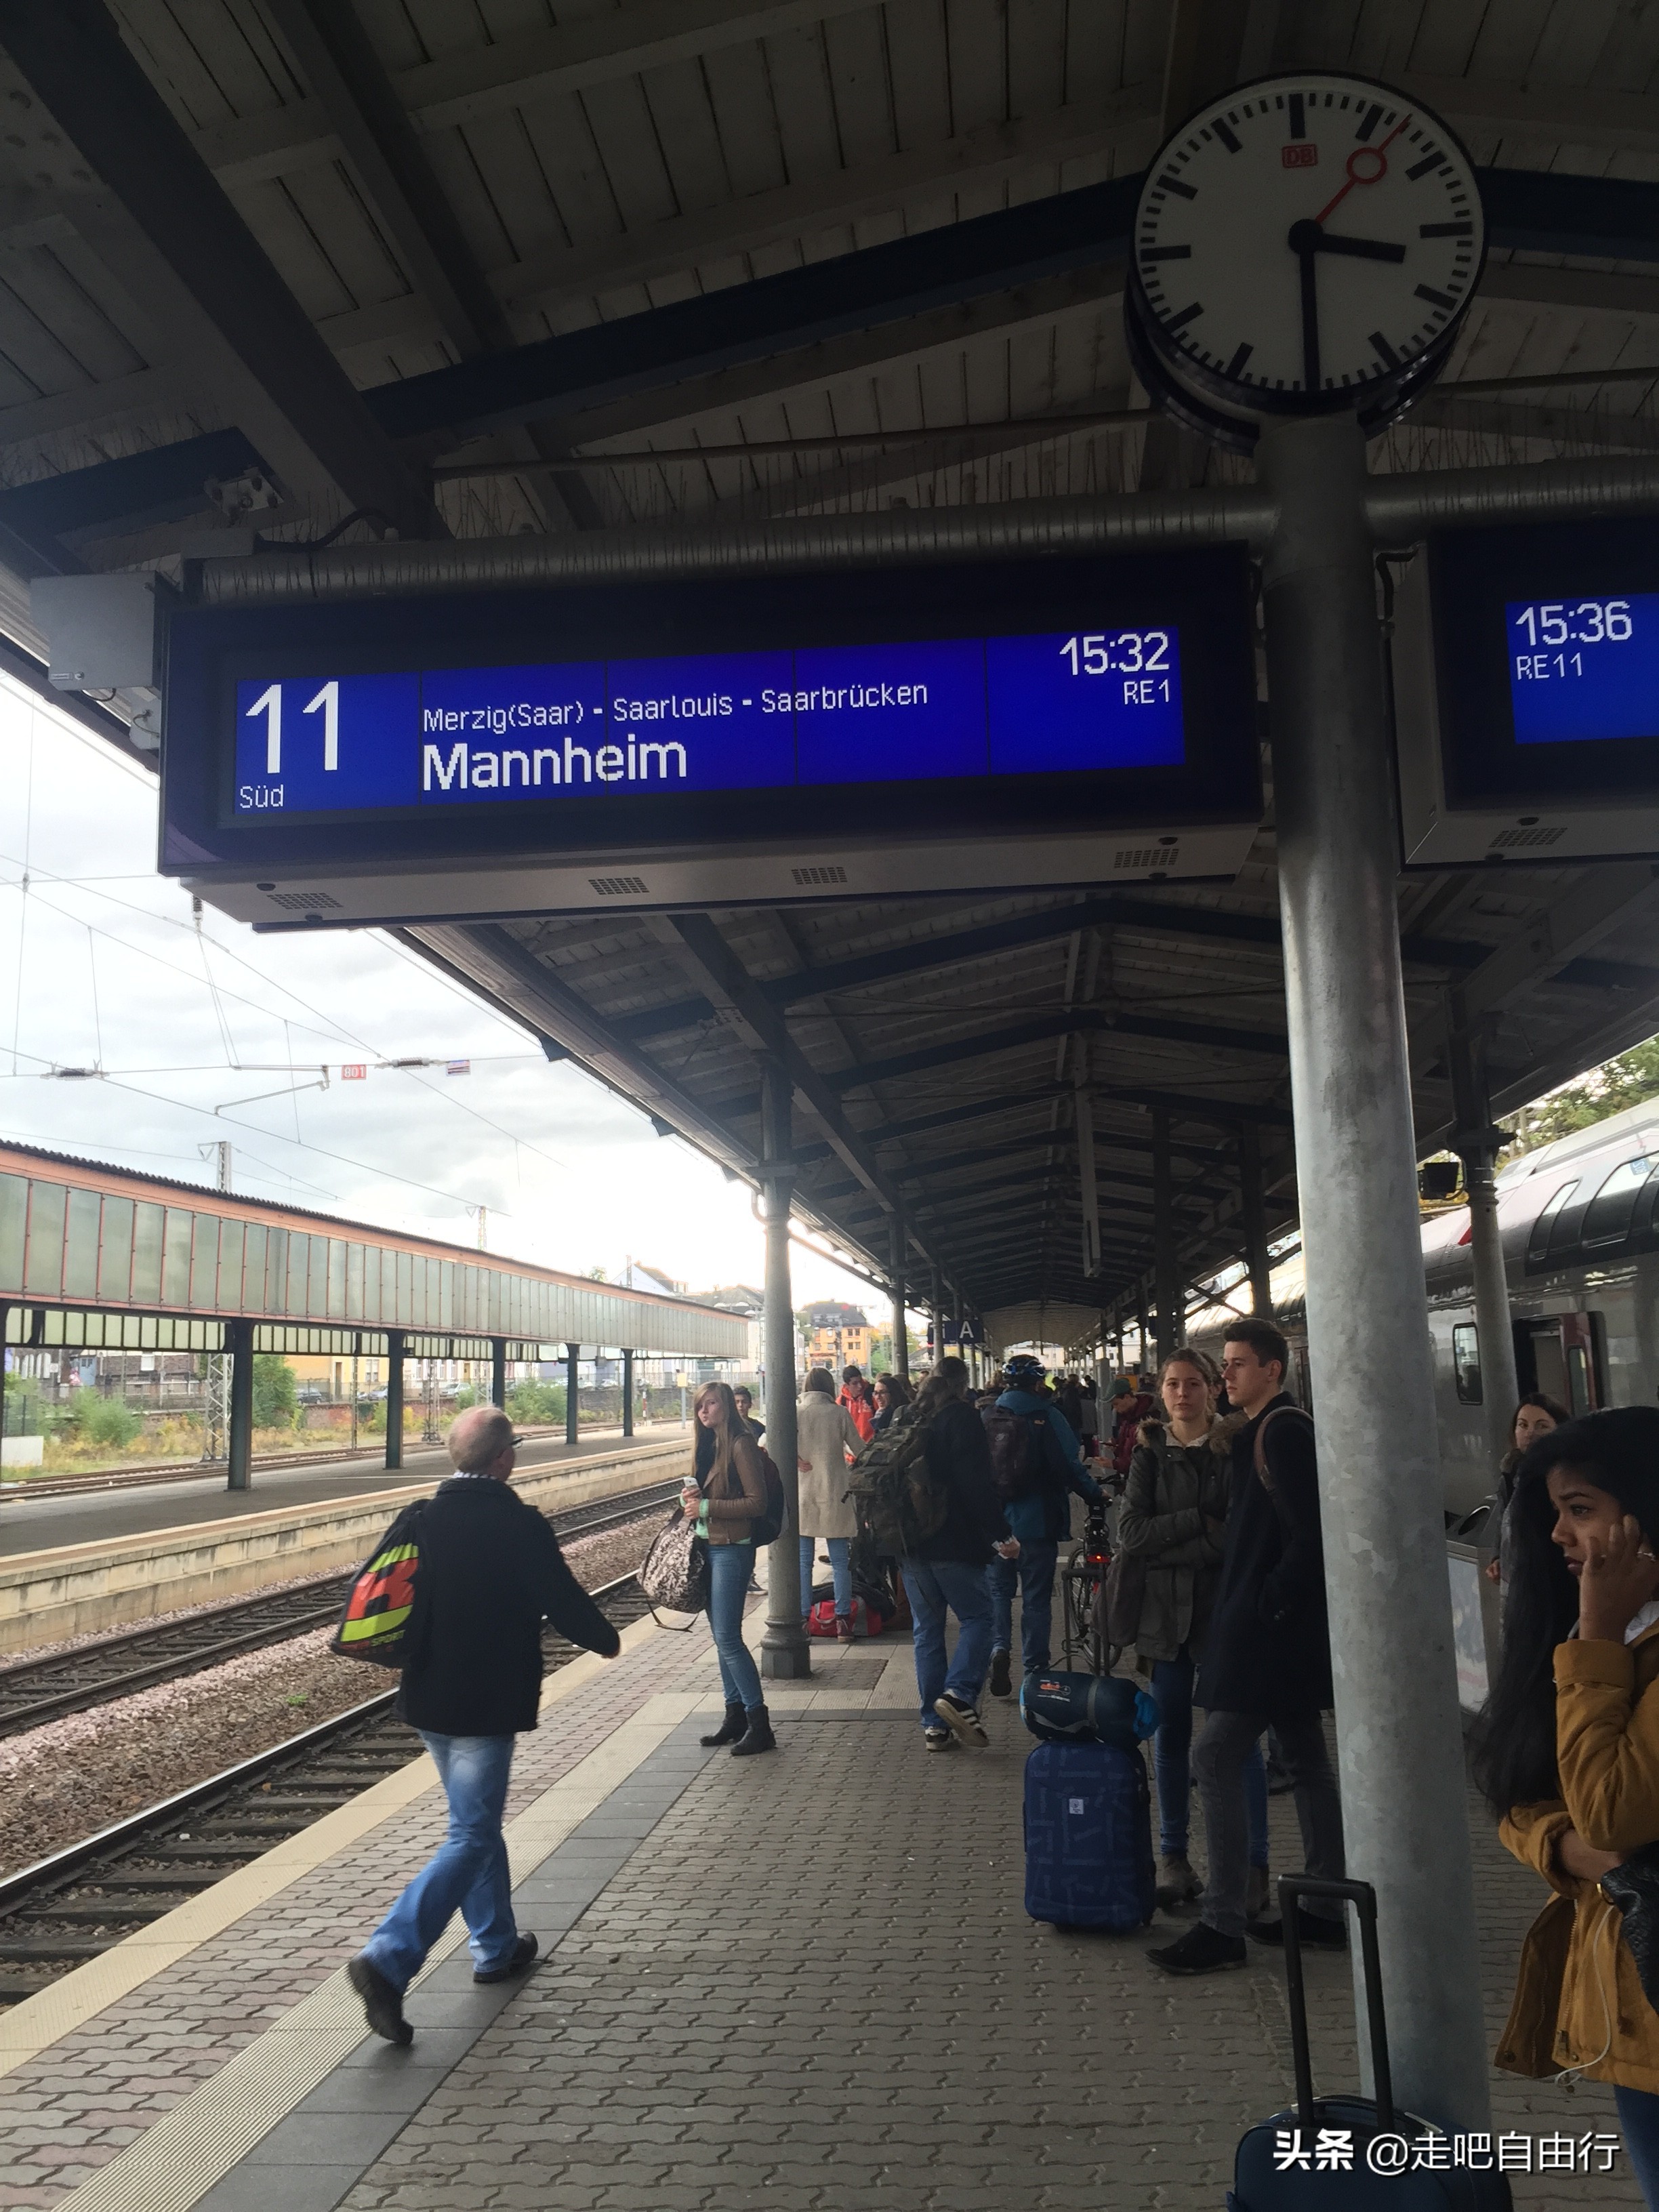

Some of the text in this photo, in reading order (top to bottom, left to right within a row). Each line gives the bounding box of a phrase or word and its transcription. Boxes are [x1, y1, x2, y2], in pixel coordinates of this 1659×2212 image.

[1285, 147, 1315, 165] DB
[1515, 601, 1633, 646] 15:36
[1059, 632, 1170, 676] 15:32
[245, 681, 339, 774] 11
[424, 701, 583, 734] Merzig(Saar)
[613, 693, 733, 722] Saarlouis
[762, 682, 928, 713] Saarbrücken
[424, 733, 687, 791] Mannheim
[239, 784, 285, 808] Süd
[344, 1066, 365, 1078] 801
[959, 1321, 974, 1338] A
